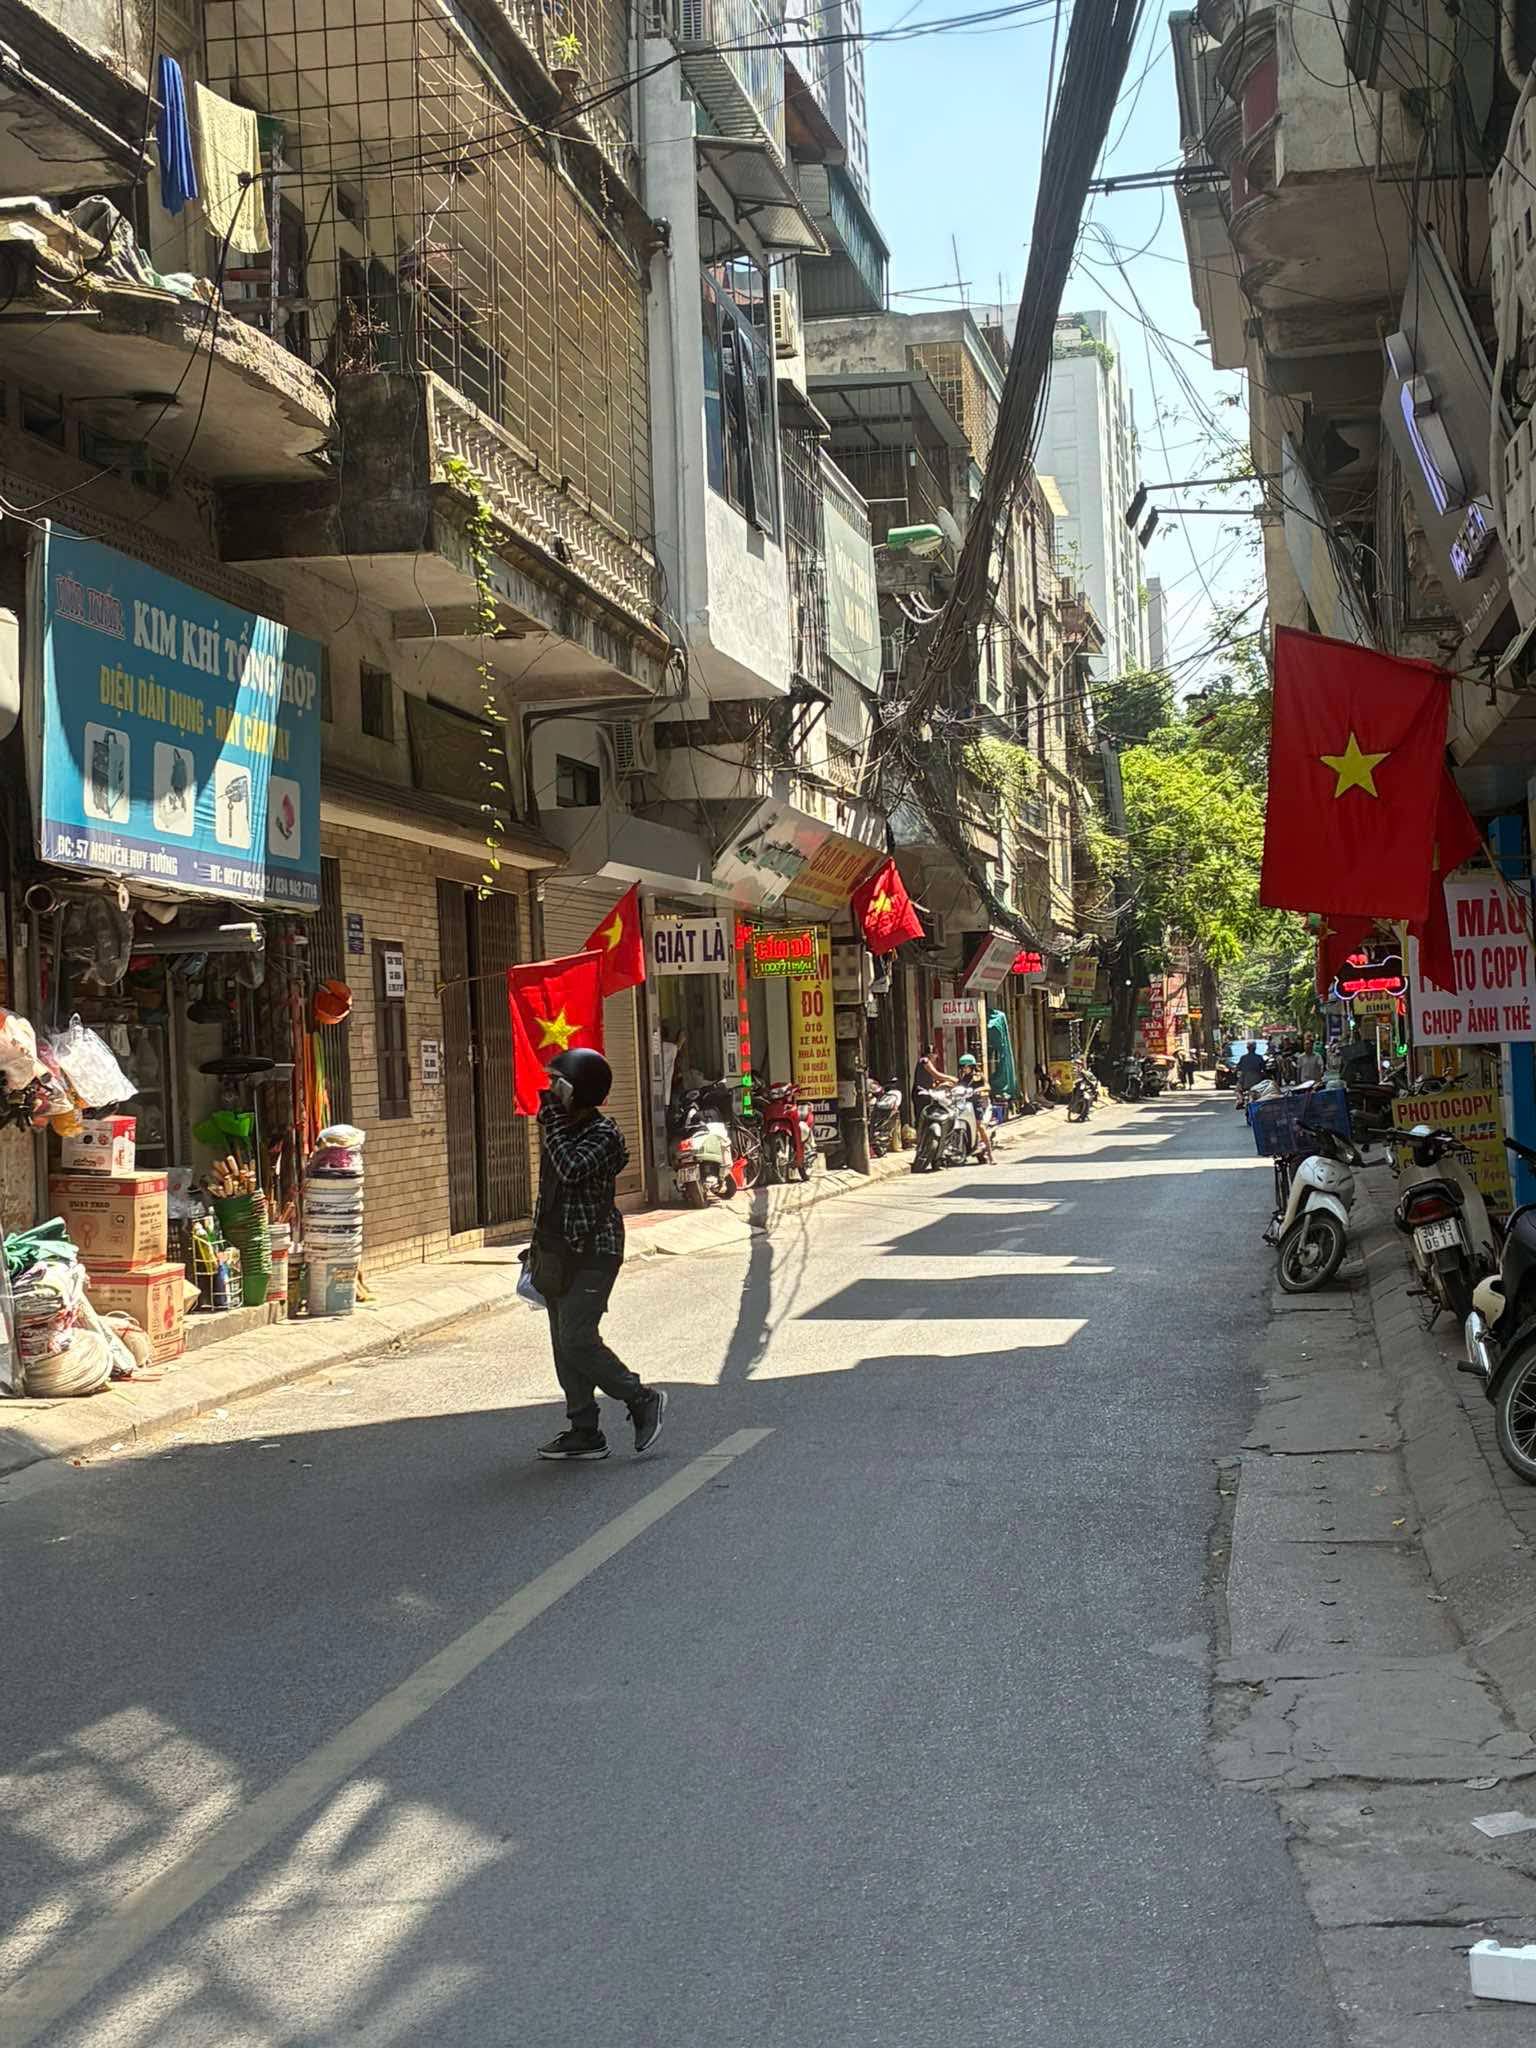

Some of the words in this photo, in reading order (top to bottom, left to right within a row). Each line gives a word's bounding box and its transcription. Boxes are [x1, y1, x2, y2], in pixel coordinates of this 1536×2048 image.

[133, 599, 177, 660] KIM
[182, 619, 220, 677] KHÍ
[225, 621, 277, 697] TỔNG
[282, 661, 317, 718] HỢP
[99, 662, 134, 717] ĐIỆN
[138, 673, 166, 722] DÂN
[169, 689, 204, 737] DỤNG
[215, 703, 241, 747] MÁY
[77, 839, 89, 859] 57
[1456, 889, 1527, 937] MÀU
[654, 923, 697, 971] GIẶT
[703, 922, 725, 961] LÀ
[1481, 945, 1529, 990] COPY
[800, 981, 824, 1018] ĐỒ
[1468, 999, 1500, 1033] ẢNH
[1502, 996, 1532, 1032] THẺ
[1397, 1095, 1493, 1122] PHOTOCOPY
